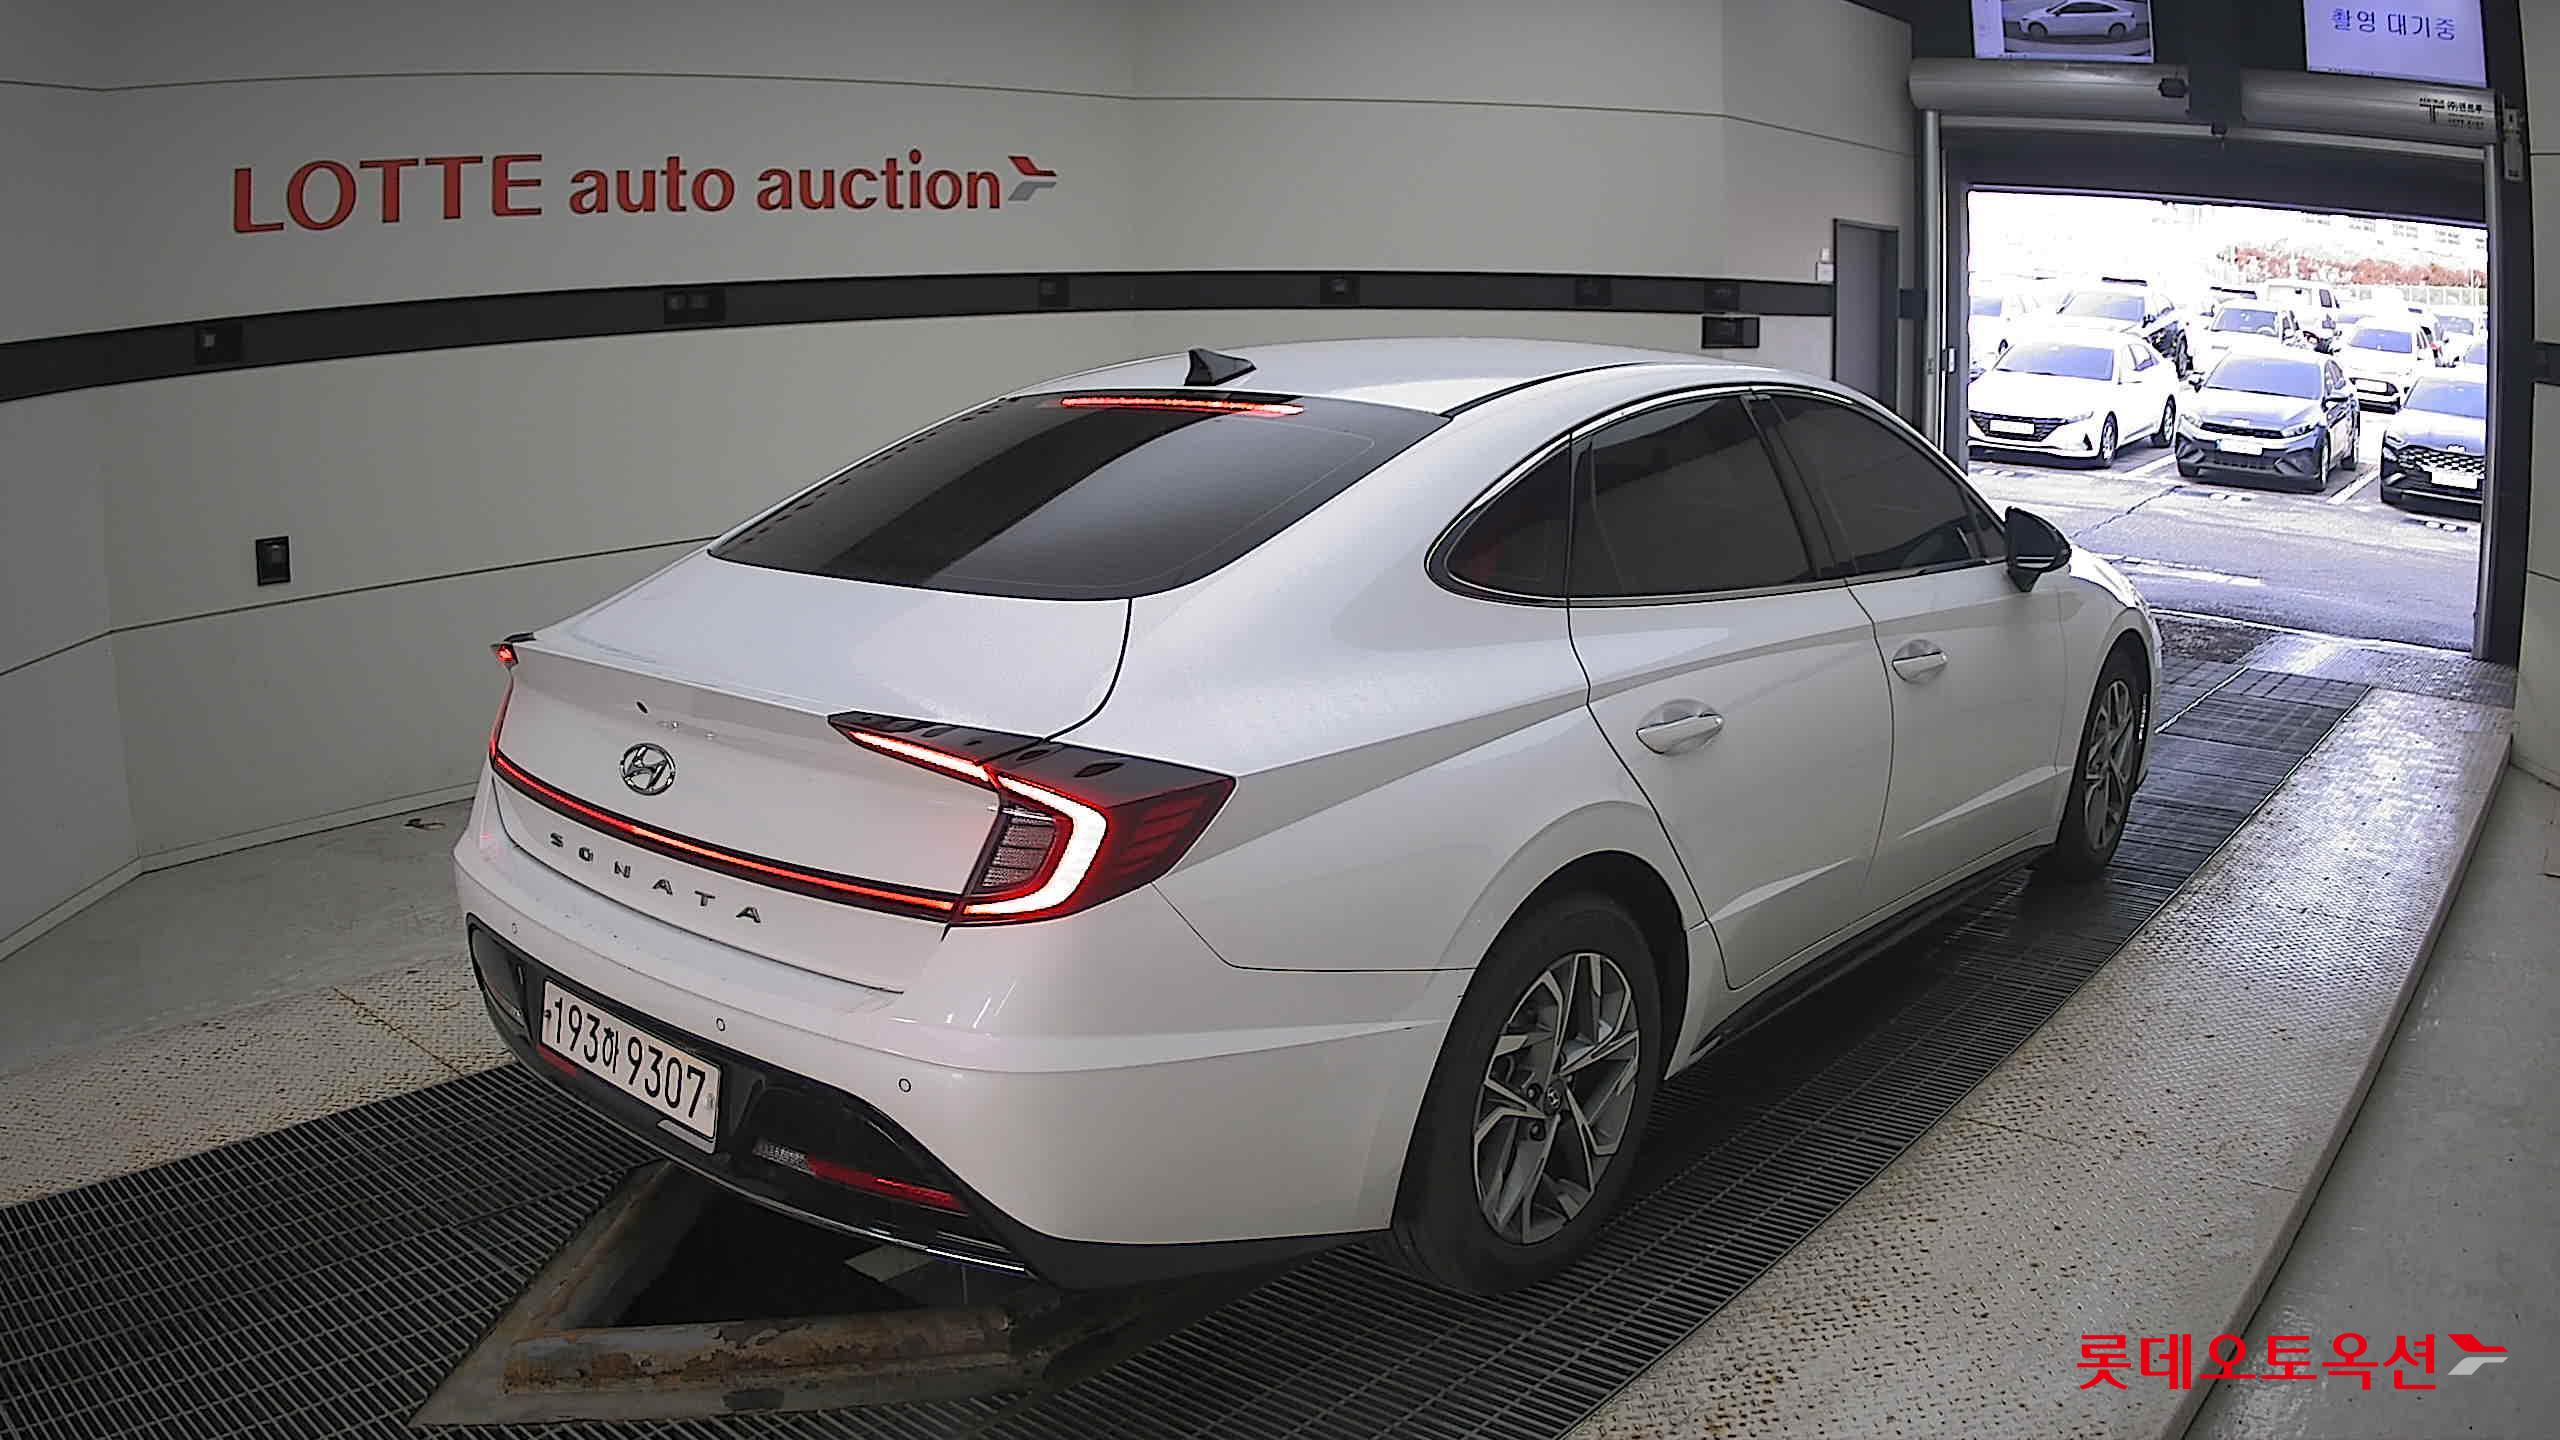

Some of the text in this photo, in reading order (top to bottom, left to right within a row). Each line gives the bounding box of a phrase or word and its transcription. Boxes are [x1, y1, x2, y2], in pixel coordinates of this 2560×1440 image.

[2331, 8, 2455, 41] 촬영 대기중
[233, 149, 1002, 233] LOTTE auto auction
[549, 832, 762, 924] SONATA
